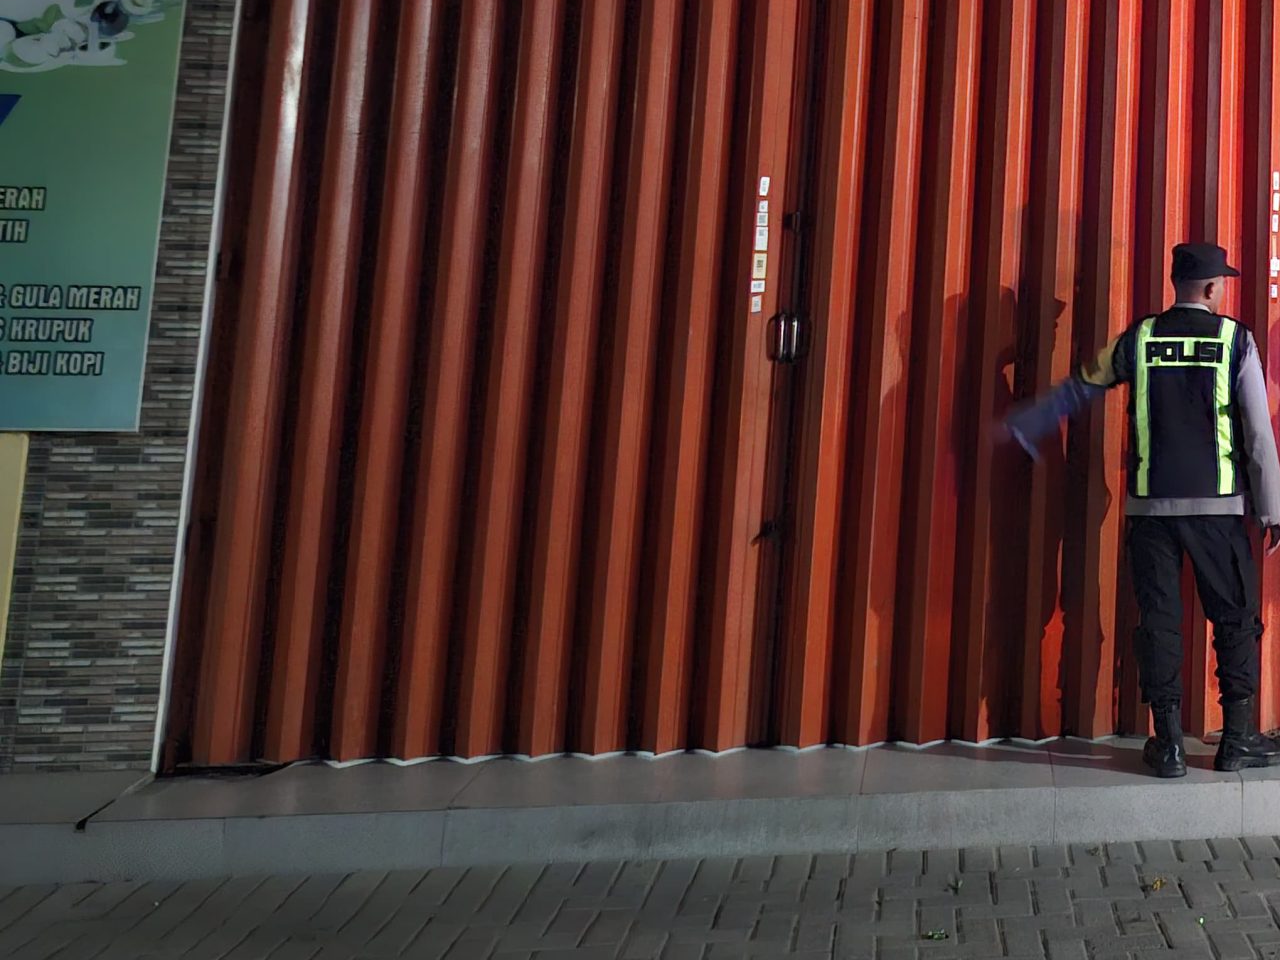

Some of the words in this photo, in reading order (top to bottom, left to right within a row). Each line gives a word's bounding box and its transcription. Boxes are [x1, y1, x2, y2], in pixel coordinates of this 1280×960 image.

[10, 284, 62, 308] GULA
[67, 286, 141, 310] MERAH
[10, 317, 94, 342] KRUPUK
[6, 350, 50, 375] BIJI
[54, 351, 105, 375] KOPI
[1145, 340, 1225, 364] POLISI
